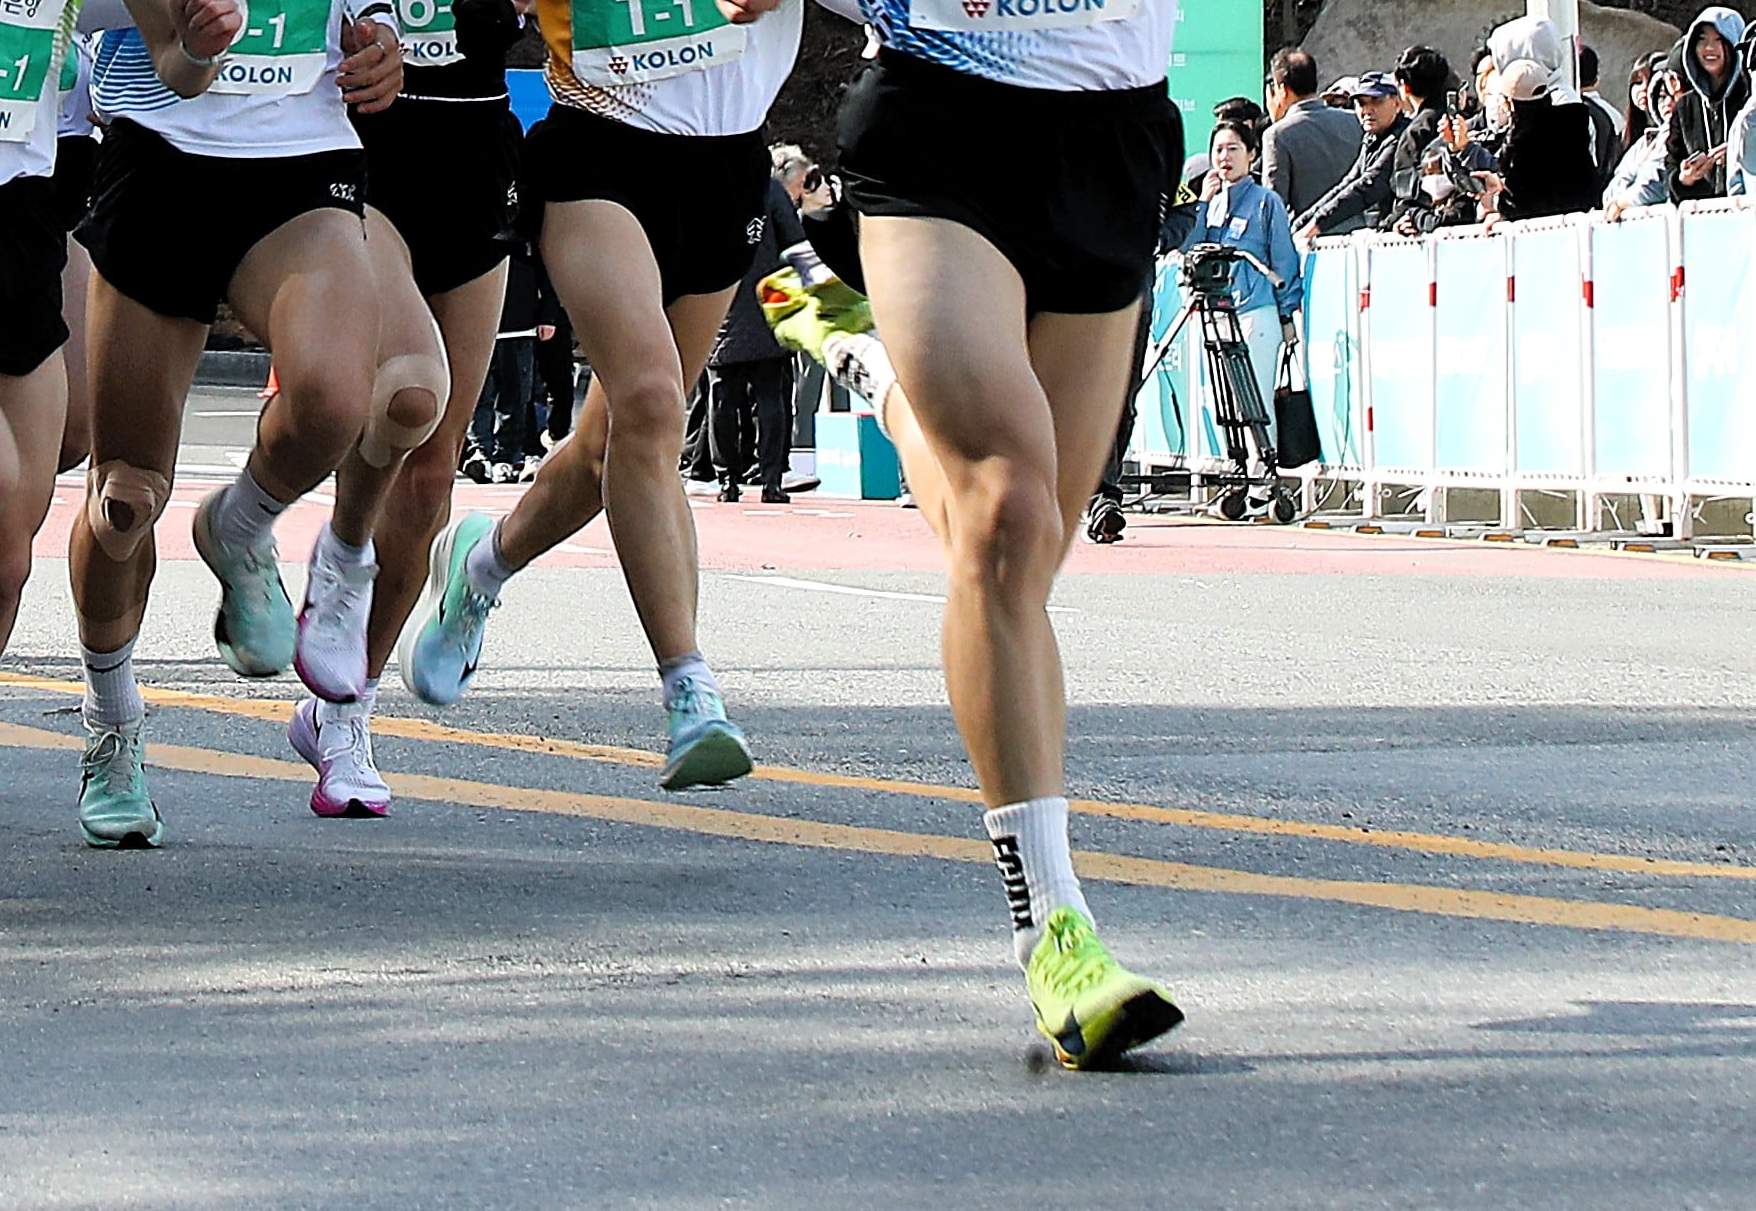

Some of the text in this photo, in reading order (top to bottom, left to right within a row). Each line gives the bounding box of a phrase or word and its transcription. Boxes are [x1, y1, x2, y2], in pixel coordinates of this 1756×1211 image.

[414, 42, 454, 59] KOL
[633, 41, 714, 71] KOLON
[216, 65, 292, 85] KOLON
